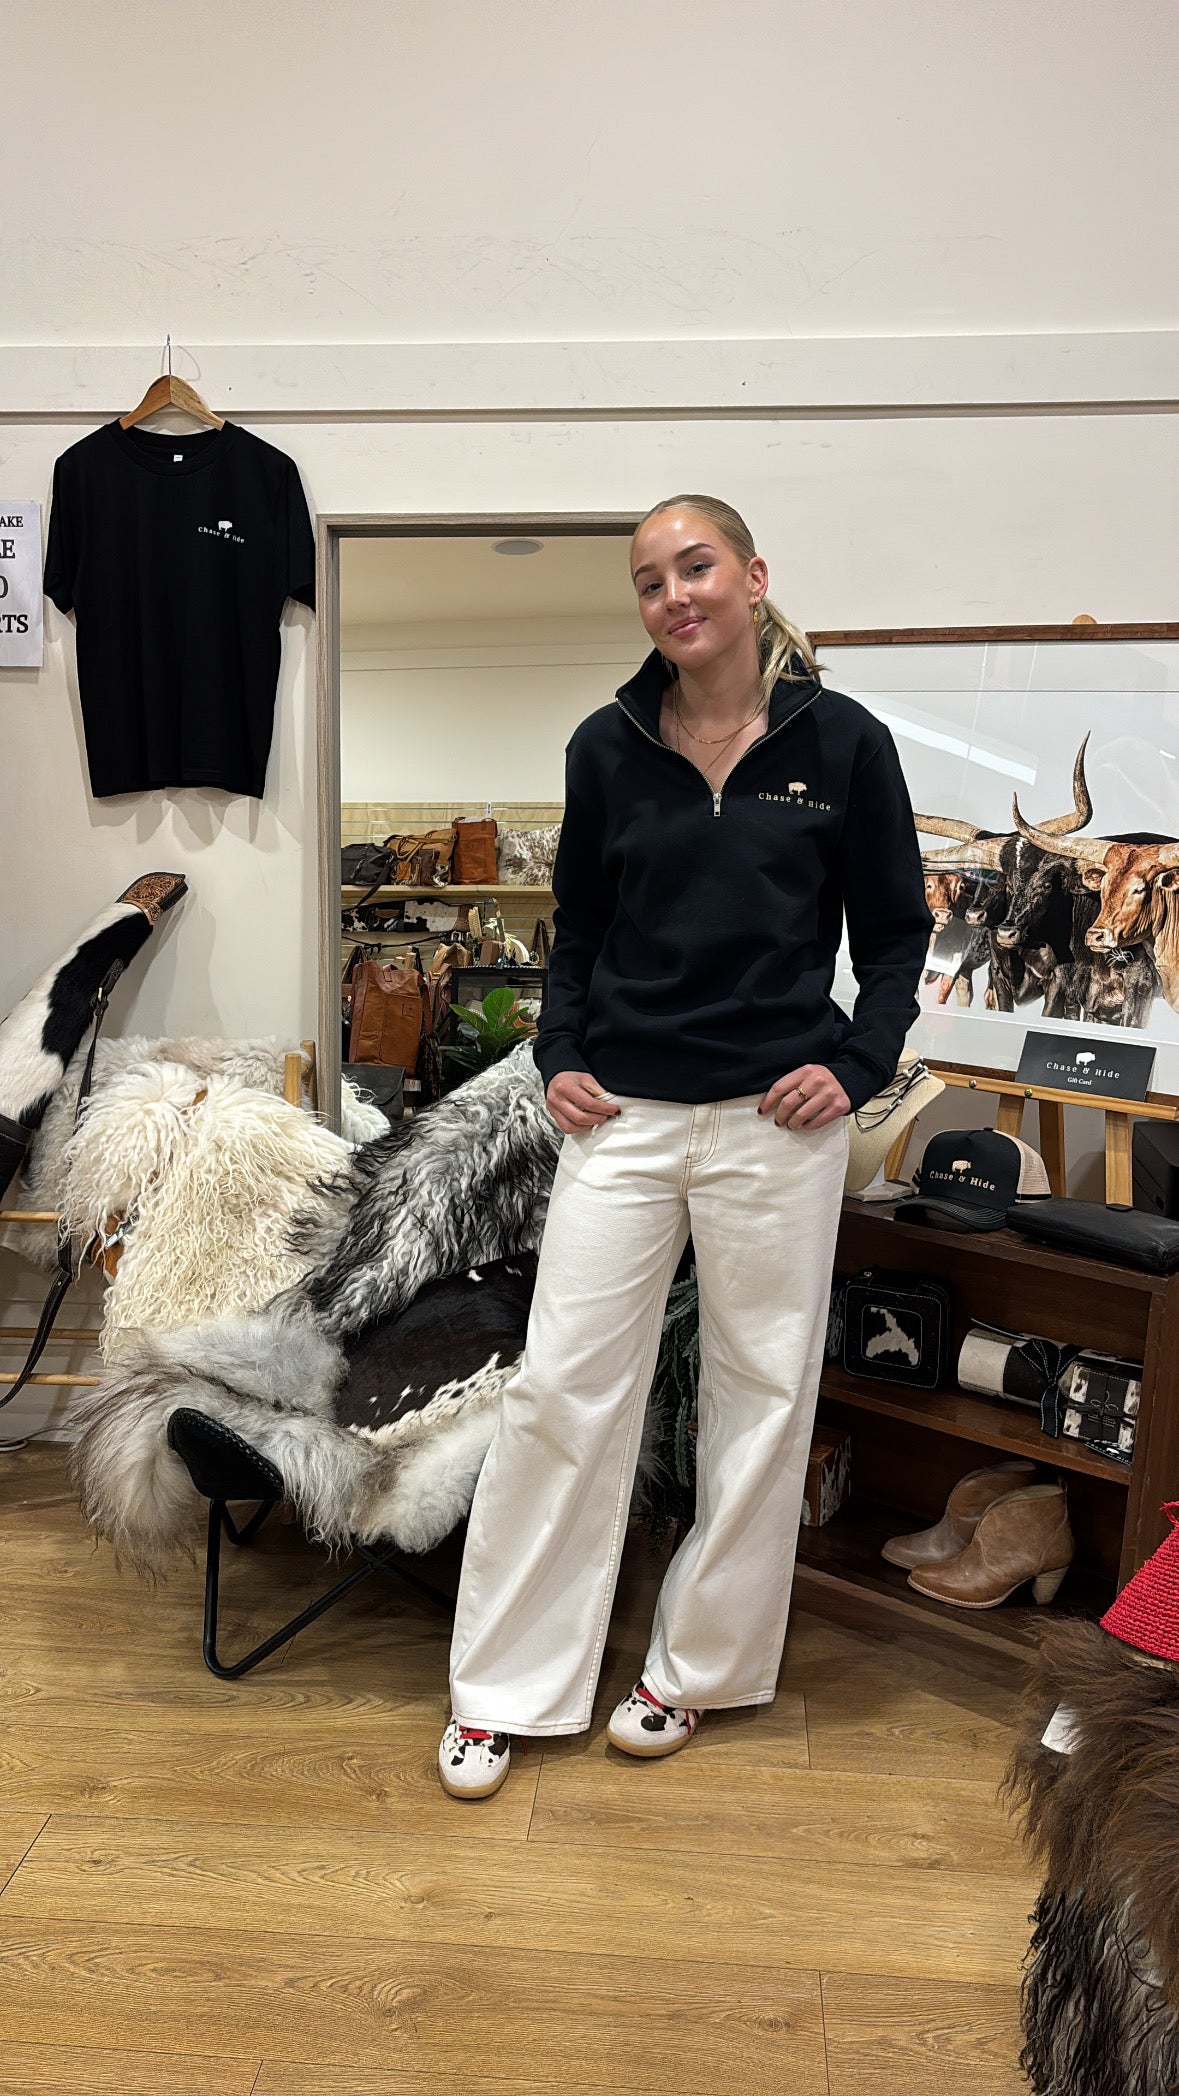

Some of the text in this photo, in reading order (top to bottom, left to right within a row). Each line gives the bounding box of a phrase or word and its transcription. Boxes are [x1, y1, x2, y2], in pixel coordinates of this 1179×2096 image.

[758, 792, 831, 811] Chase & Hide
[1046, 1061, 1120, 1079] Chase & Hide
[1067, 1076, 1092, 1086] Gift Card
[929, 1170, 996, 1192] Chase & Hide
